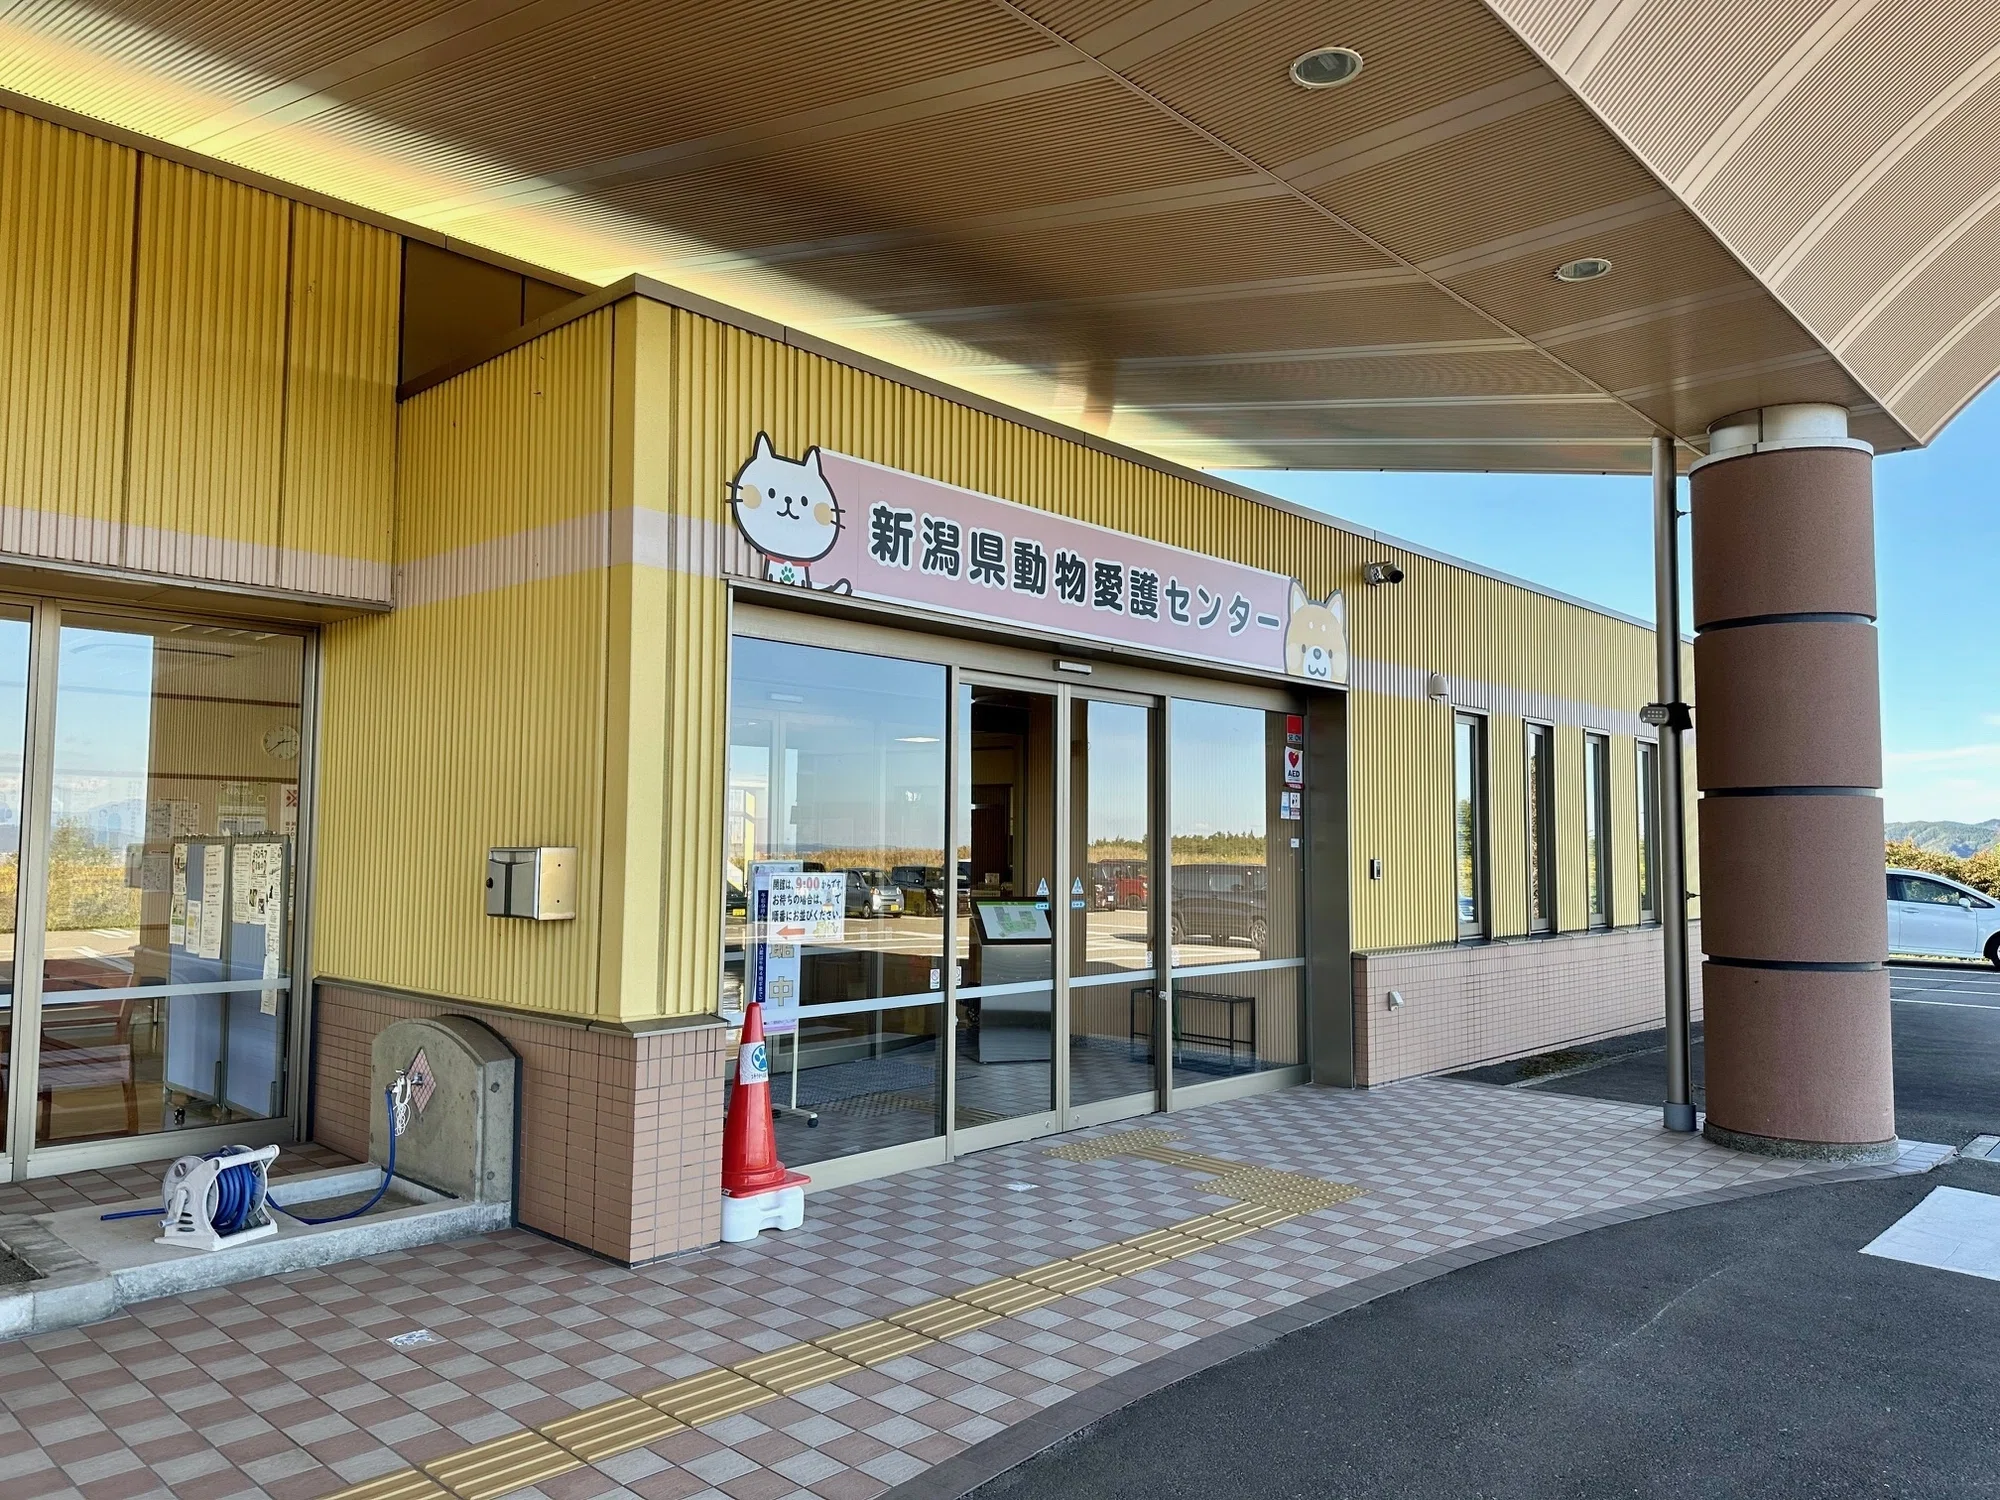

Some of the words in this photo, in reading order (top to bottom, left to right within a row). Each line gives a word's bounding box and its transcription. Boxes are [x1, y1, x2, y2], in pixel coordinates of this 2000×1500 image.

[869, 505, 1280, 634] 新潟県動物愛護センター
[1288, 770, 1300, 778] AED
